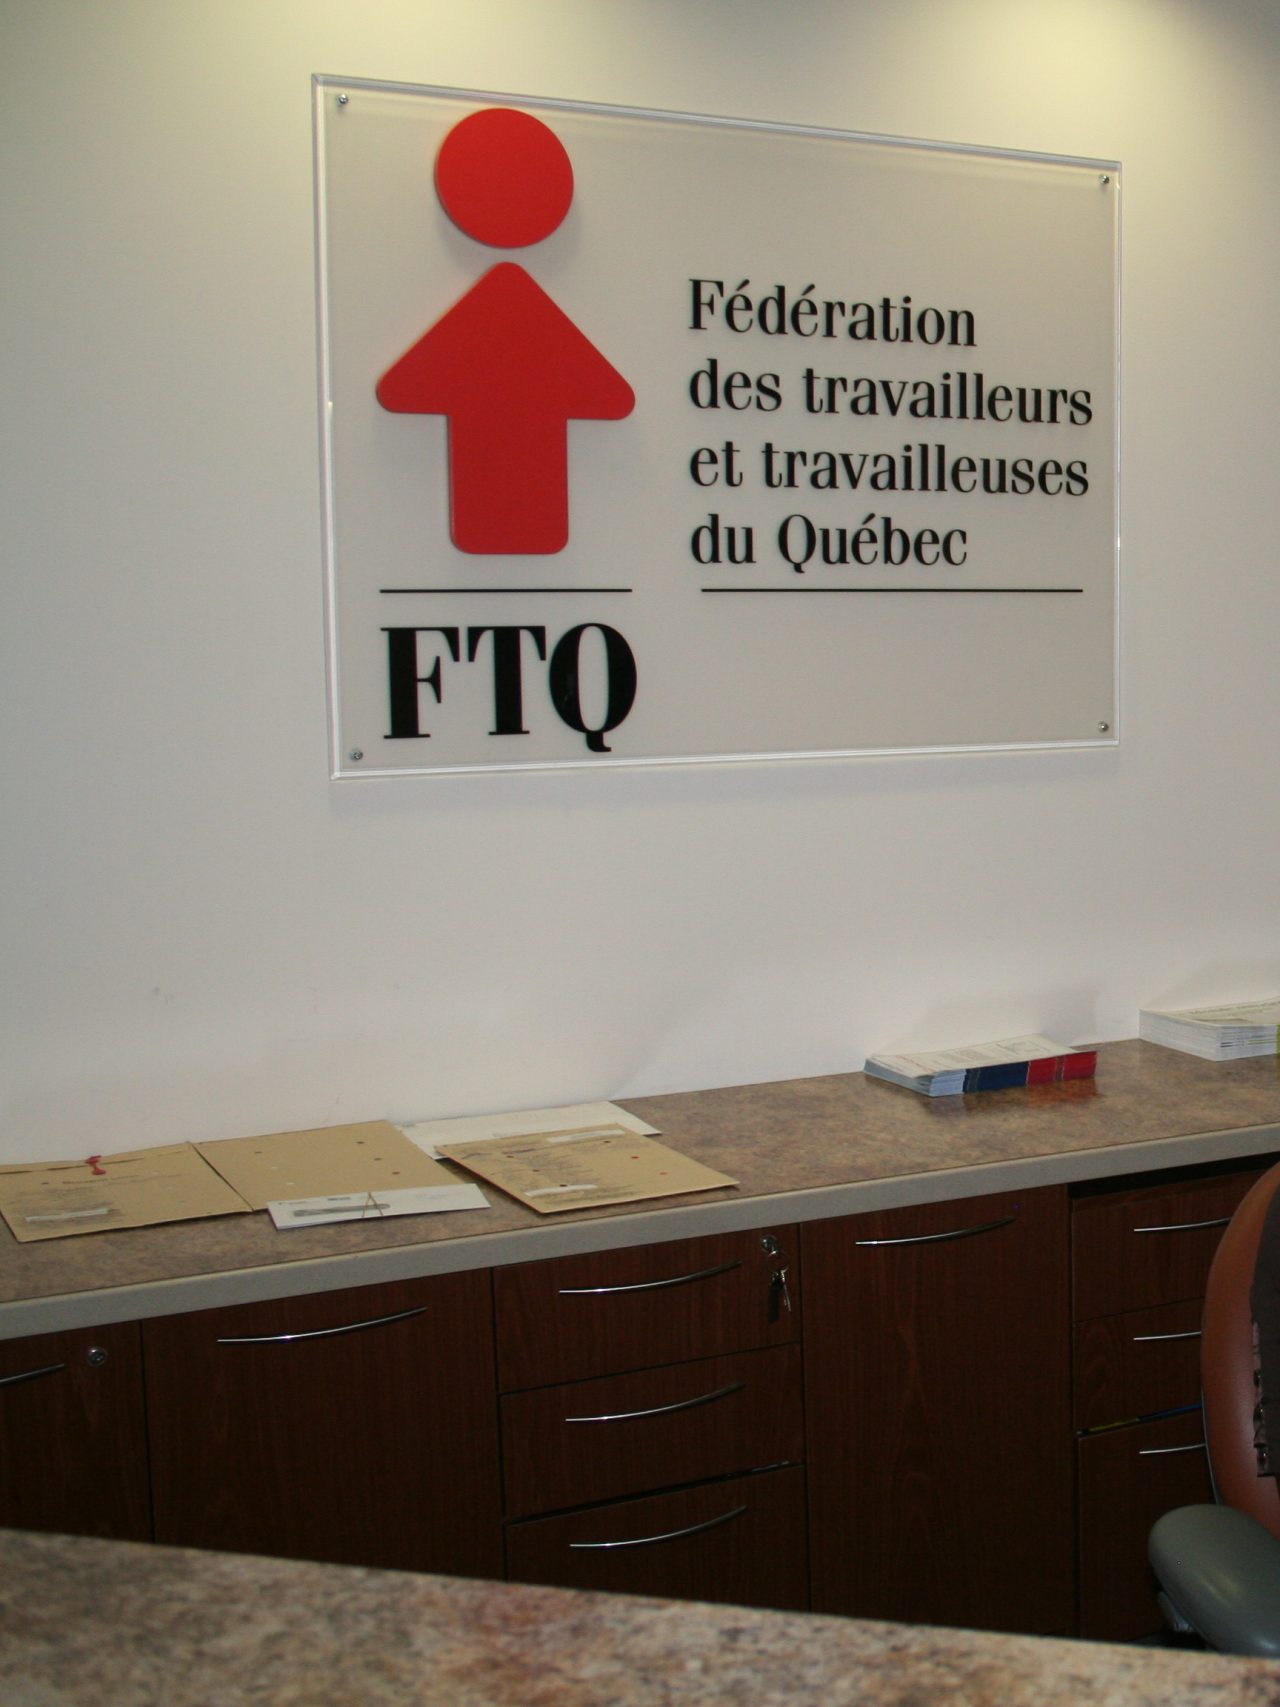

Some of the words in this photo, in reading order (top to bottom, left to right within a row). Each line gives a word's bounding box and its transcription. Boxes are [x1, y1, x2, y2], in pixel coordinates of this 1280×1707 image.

[689, 279, 978, 347] Fédération
[689, 358, 783, 412] des
[802, 368, 1093, 426] travailleurs
[689, 441, 743, 488] et
[761, 442, 1089, 497] travailleuses
[691, 513, 756, 566] du
[777, 512, 968, 574] Québec
[380, 622, 637, 753] FTQ
